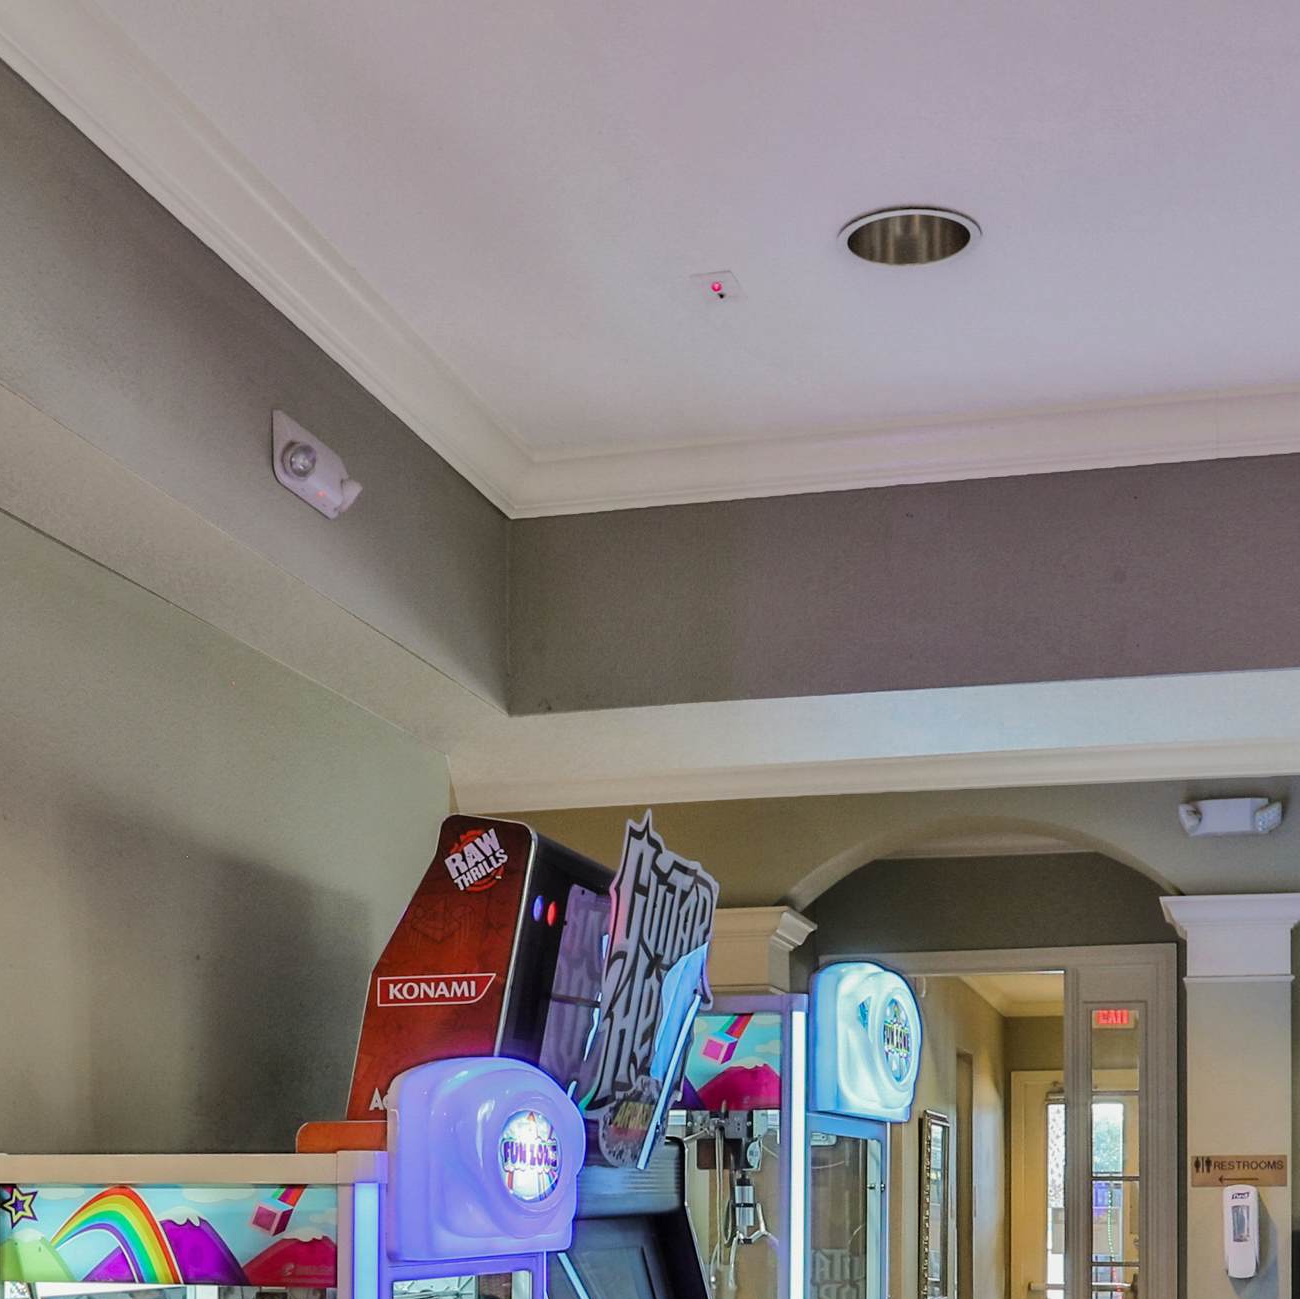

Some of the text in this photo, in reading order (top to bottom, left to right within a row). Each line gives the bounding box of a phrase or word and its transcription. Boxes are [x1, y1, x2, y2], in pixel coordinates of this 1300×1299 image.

[444, 828, 501, 879] RAW
[454, 848, 508, 892] THRILLS
[389, 981, 476, 1000] KONAMI
[503, 1141, 527, 1166] FUN
[1213, 1160, 1285, 1171] RESTROOMS
